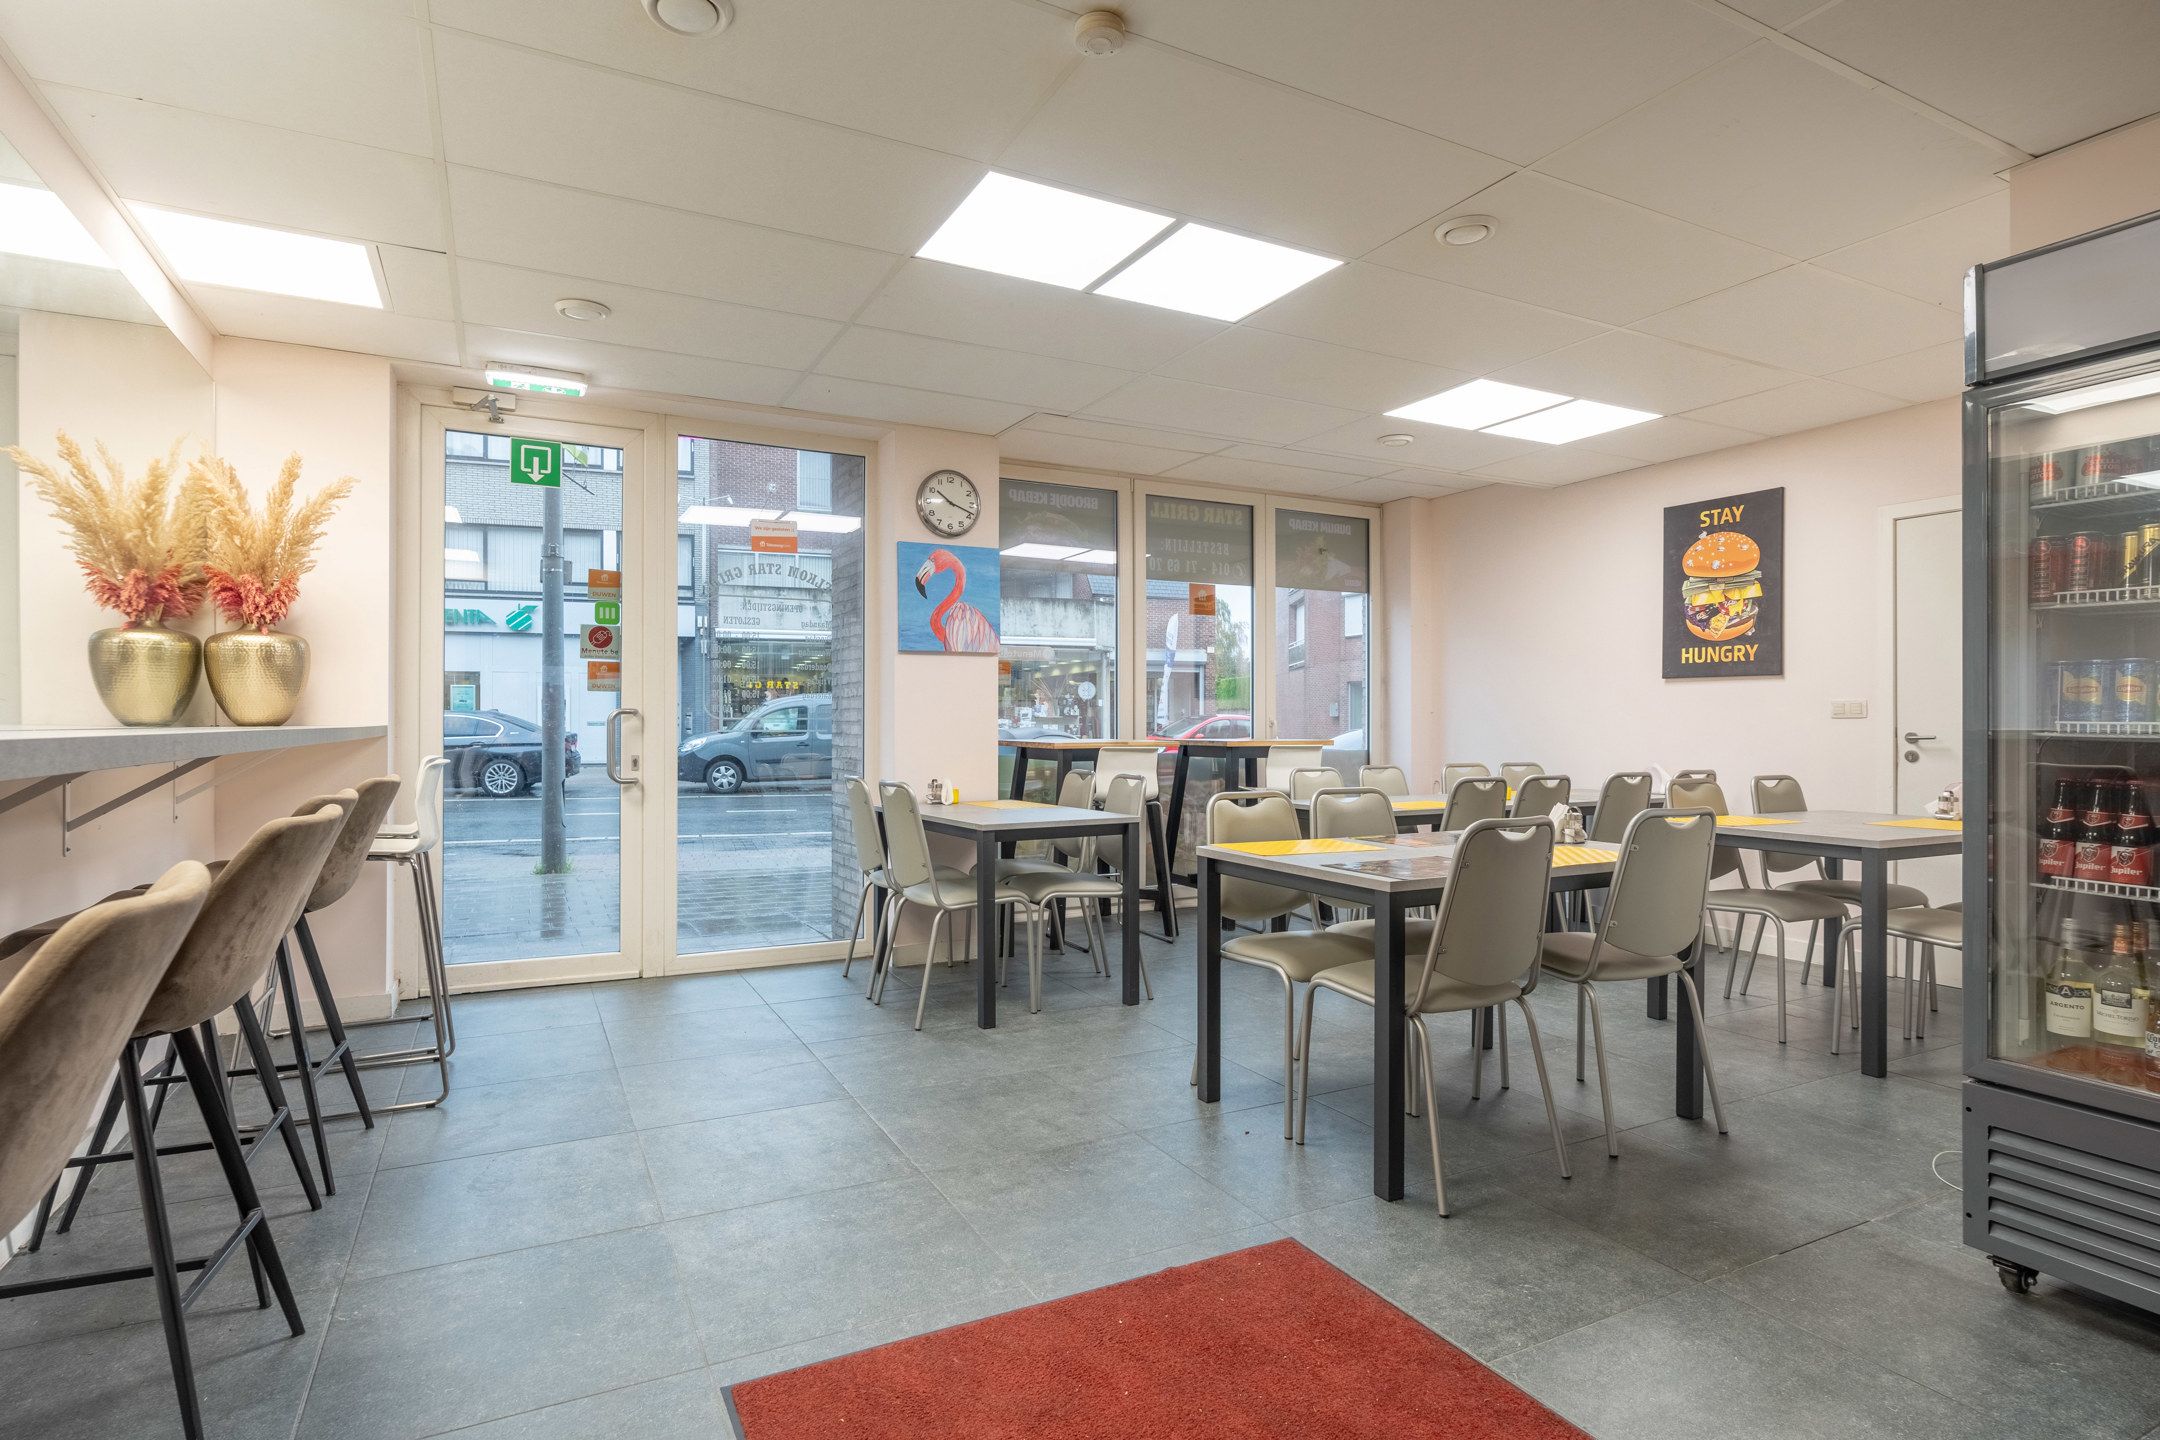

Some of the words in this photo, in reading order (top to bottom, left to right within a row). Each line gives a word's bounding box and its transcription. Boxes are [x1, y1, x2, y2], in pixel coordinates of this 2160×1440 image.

[1700, 505, 1745, 527] STAY
[581, 647, 619, 656] Menute.be
[1681, 644, 1759, 664] HUNGRY
[2075, 862, 2106, 871] Jupiler
[2111, 866, 2143, 876] Jupiler
[2061, 986, 2071, 996] A
[2050, 1001, 2085, 1010] ARGENTO
